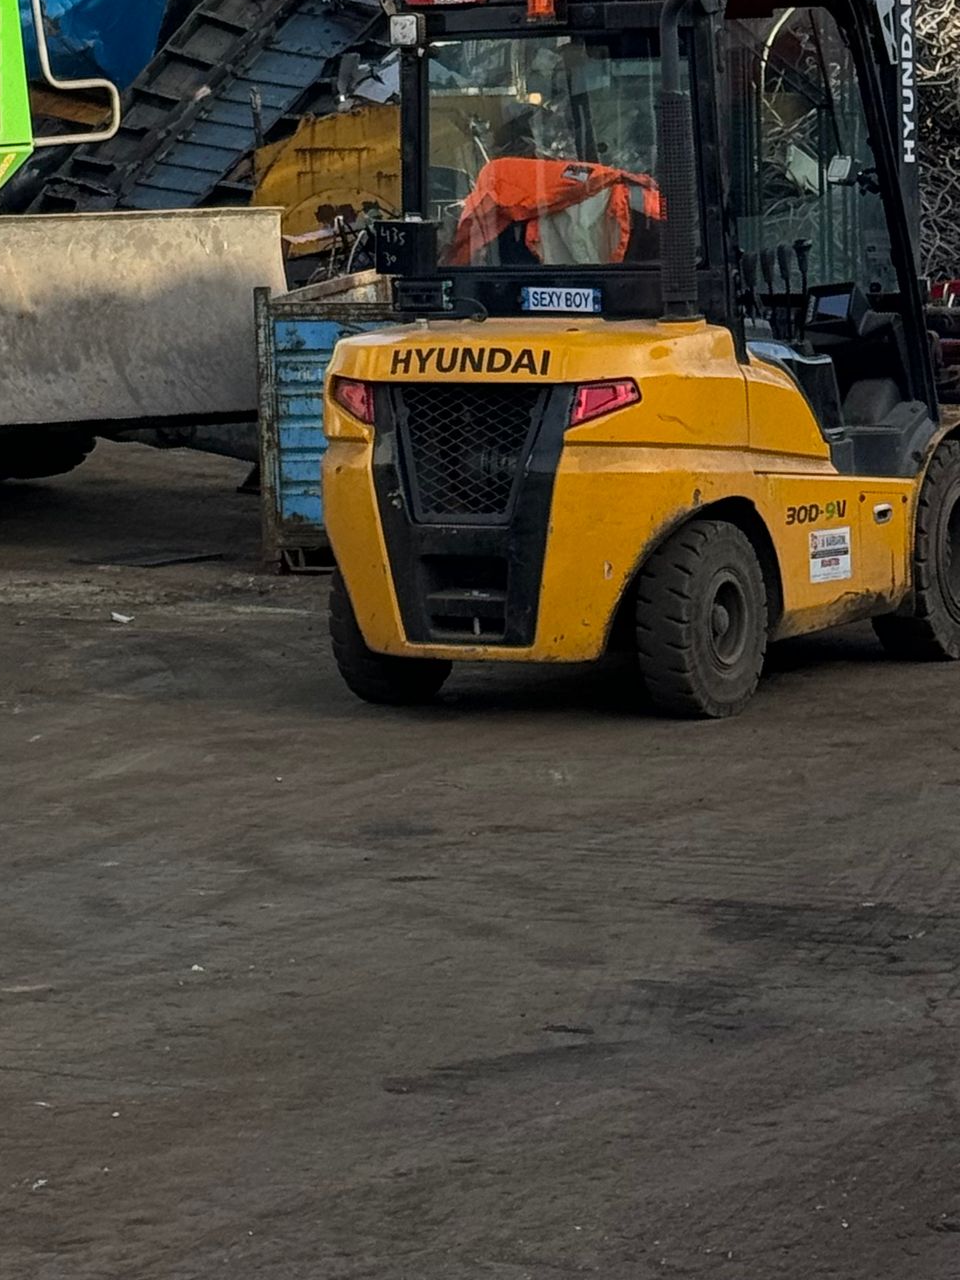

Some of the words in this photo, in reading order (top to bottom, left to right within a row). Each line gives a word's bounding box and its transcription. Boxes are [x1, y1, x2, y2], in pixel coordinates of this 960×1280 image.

[532, 291, 562, 307] SEXY
[565, 292, 590, 308] BOY
[390, 347, 551, 375] HYUNDAI
